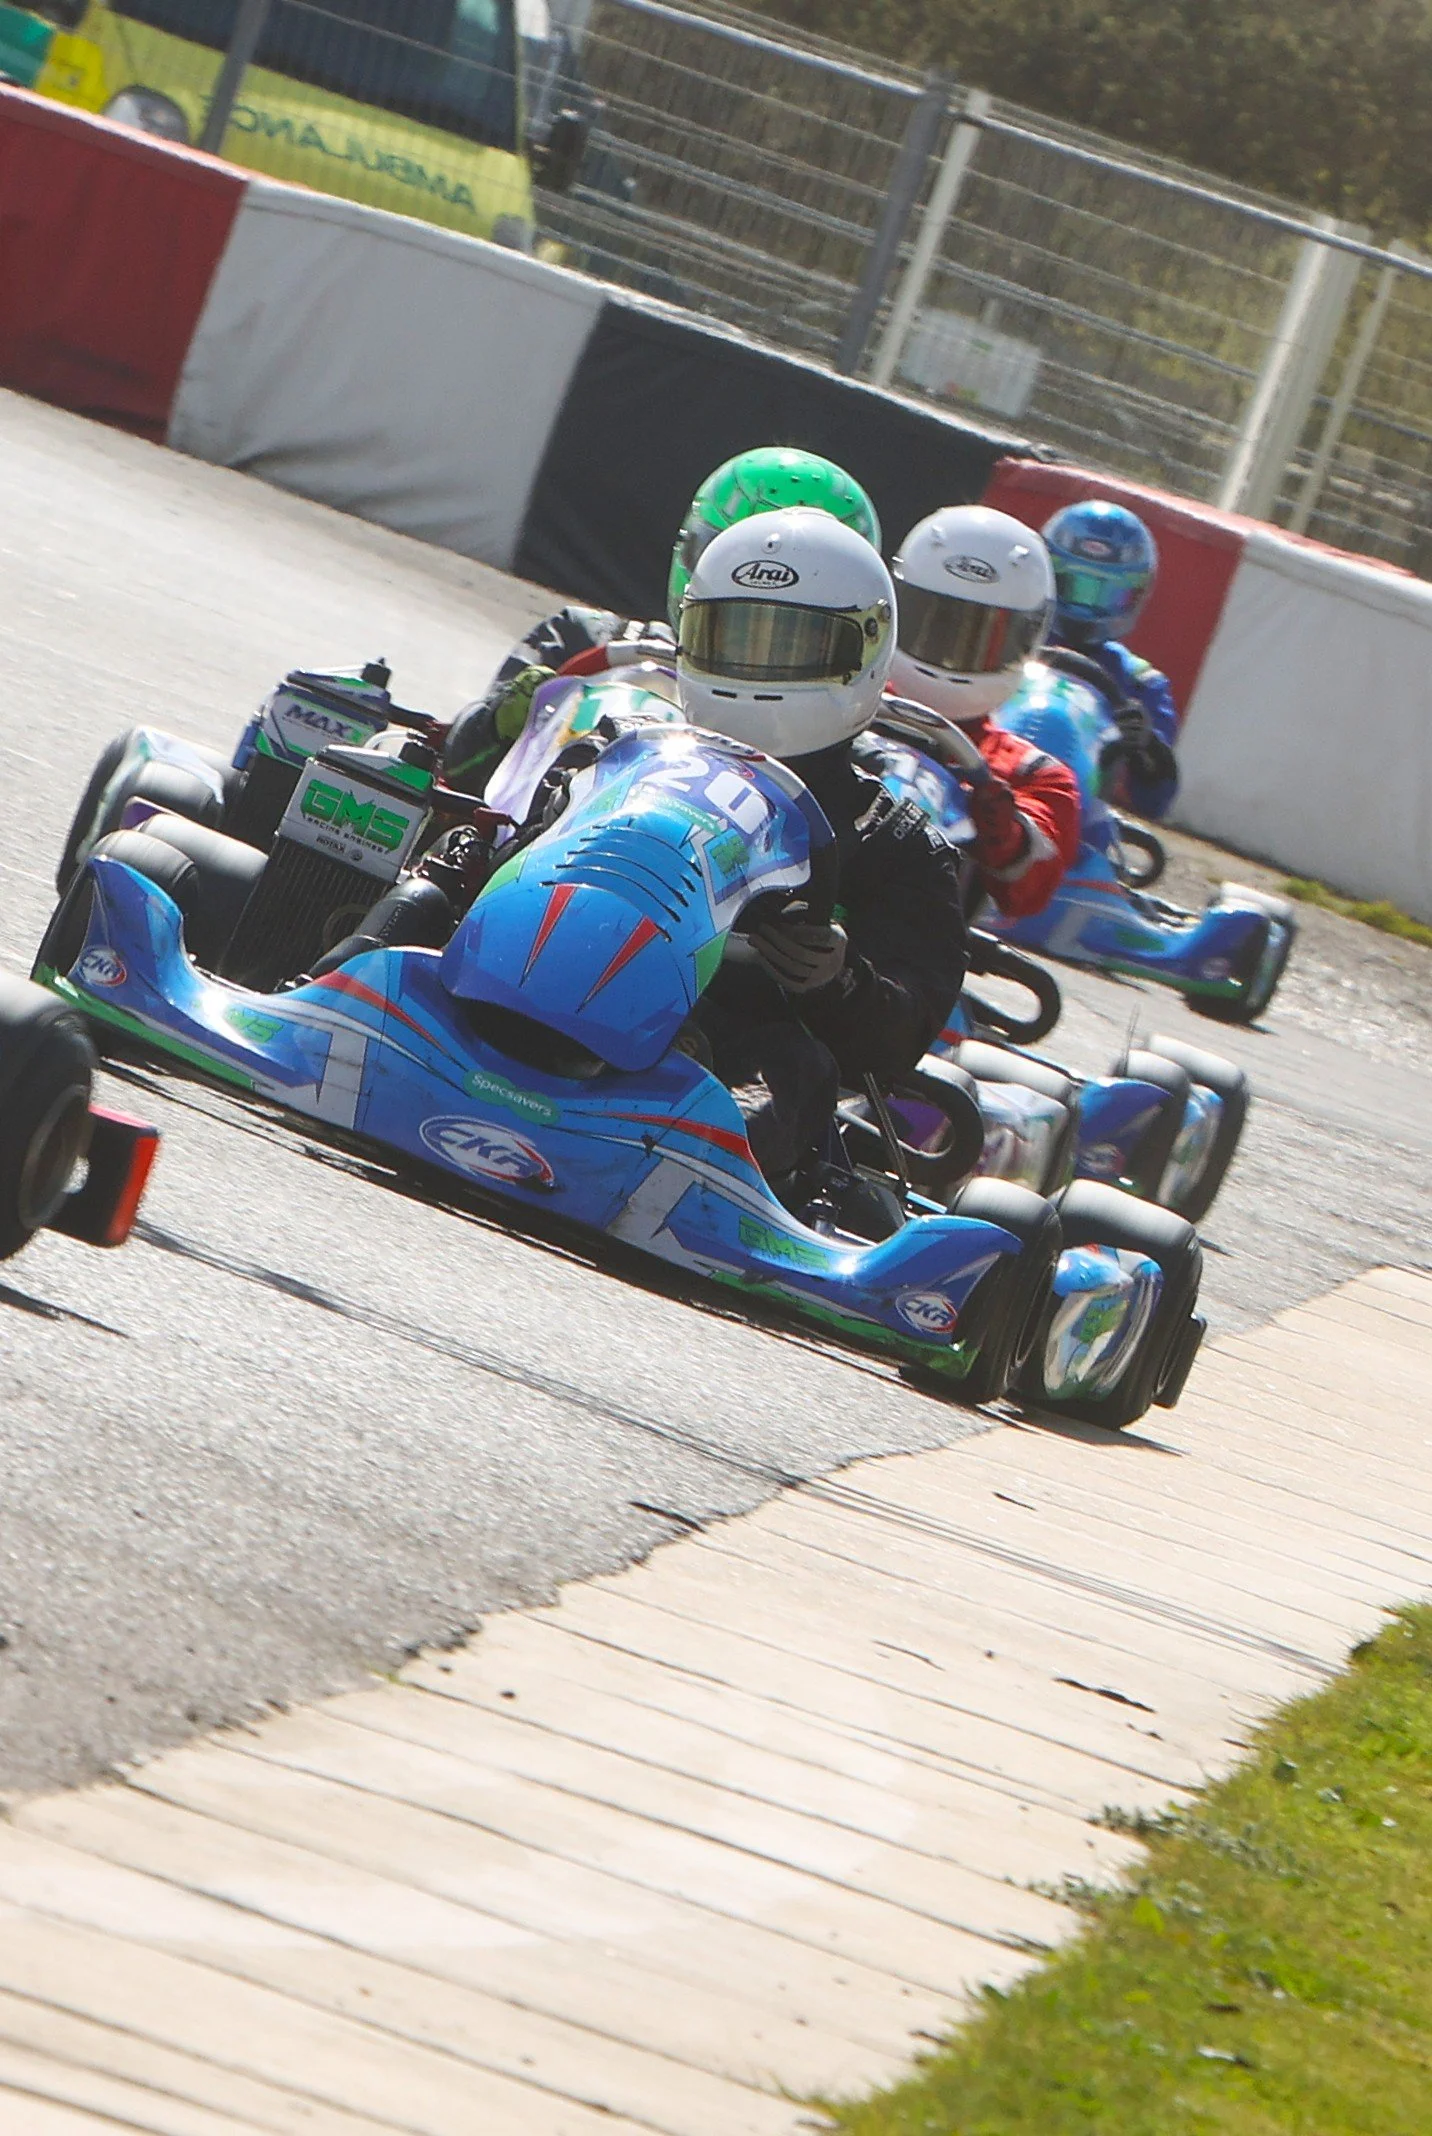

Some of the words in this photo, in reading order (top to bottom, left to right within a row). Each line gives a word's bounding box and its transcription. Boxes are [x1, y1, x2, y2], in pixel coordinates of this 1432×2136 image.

[736, 560, 793, 582] Arai
[283, 703, 350, 738] MAX
[300, 778, 410, 852] GMS
[638, 753, 769, 835] 20
[471, 1072, 552, 1117] Specsavers
[423, 1122, 543, 1180] CKR
[899, 1296, 955, 1326] CKR
